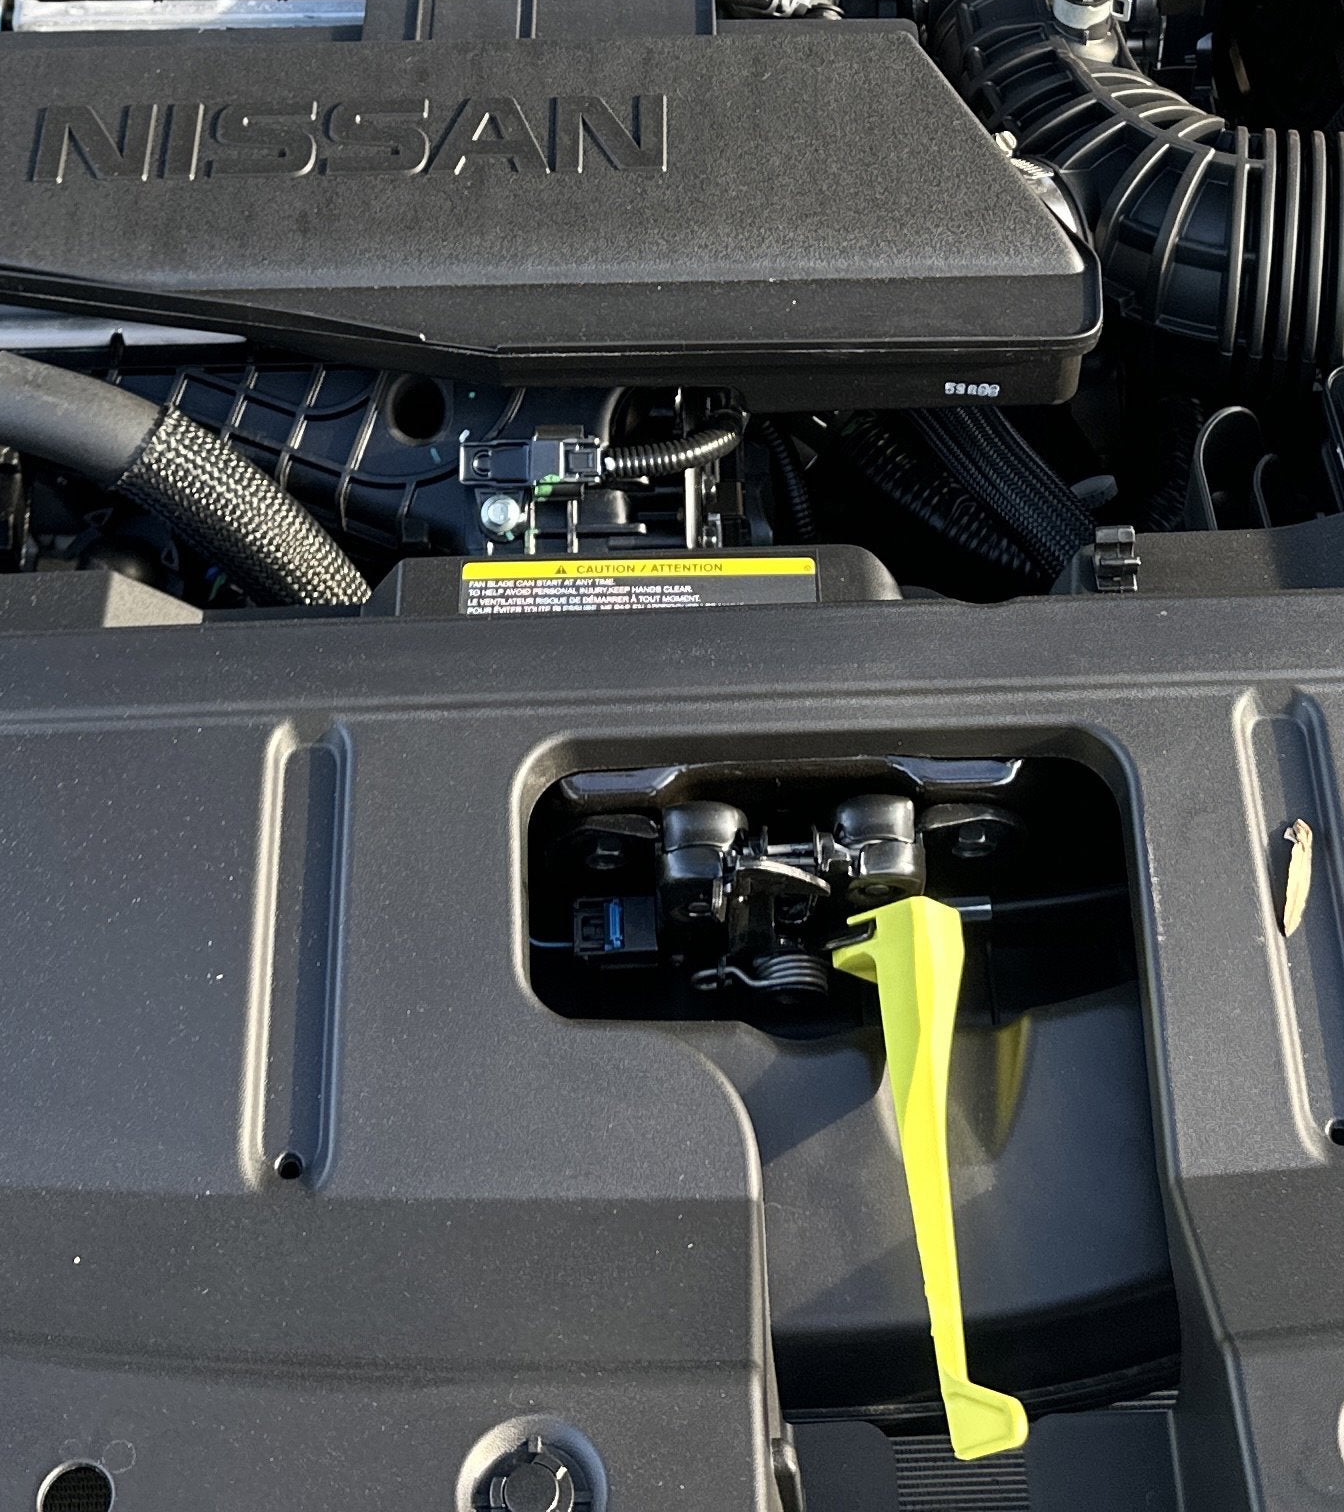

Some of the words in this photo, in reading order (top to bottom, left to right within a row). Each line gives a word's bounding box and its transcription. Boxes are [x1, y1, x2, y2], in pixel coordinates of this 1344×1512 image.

[26, 94, 668, 183] NISSAN
[576, 564, 636, 575] CAUTION
[650, 563, 723, 573] ATTENTION
[468, 580, 486, 588] FAN
[486, 580, 515, 588] BLADE
[516, 579, 535, 587] CAN
[536, 579, 562, 587] START
[563, 578, 575, 586] AT
[575, 578, 593, 586] ANY
[468, 589, 480, 597] TO
[481, 588, 504, 596] HELP
[505, 588, 532, 596] AVOID
[532, 587, 577, 595] PERSONAL
[631, 585, 662, 593] HANDS
[663, 585, 693, 593] CLEAR.
[467, 598, 478, 606] LE
[479, 597, 534, 606] VENTILATEUR
[535, 596, 568, 604] RISQUE
[568, 596, 581, 604] DE
[582, 594, 630, 603] DÉMARRER
[630, 594, 637, 603] À
[638, 595, 660, 603] TOUT
[661, 594, 701, 602] MOMENT.
[467, 606, 492, 614] POUR
